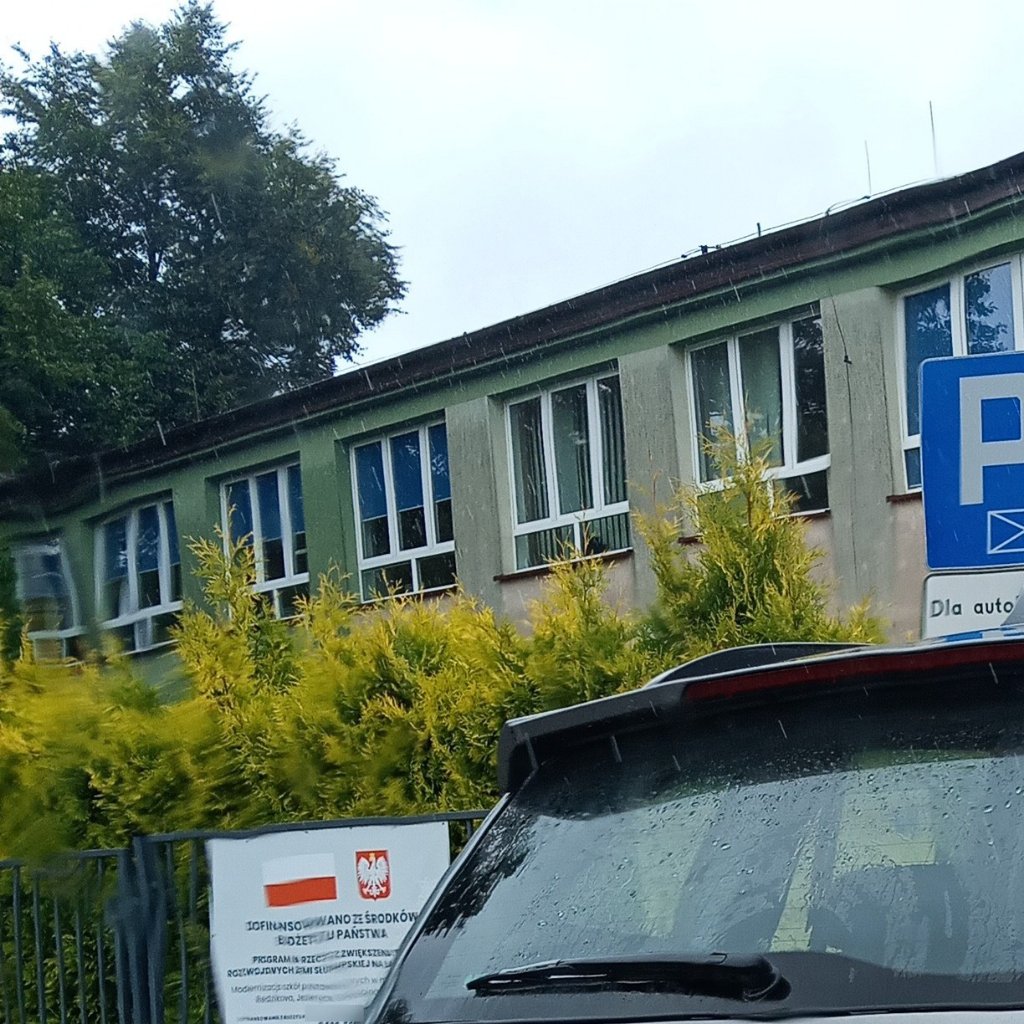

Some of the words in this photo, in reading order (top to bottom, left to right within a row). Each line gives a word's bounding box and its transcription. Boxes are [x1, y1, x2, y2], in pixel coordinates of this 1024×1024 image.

[931, 598, 962, 618] Dla
[974, 595, 1020, 615] auto
[365, 909, 418, 925] ŚRODKÓW
[336, 926, 389, 940] PAŃSTWA
